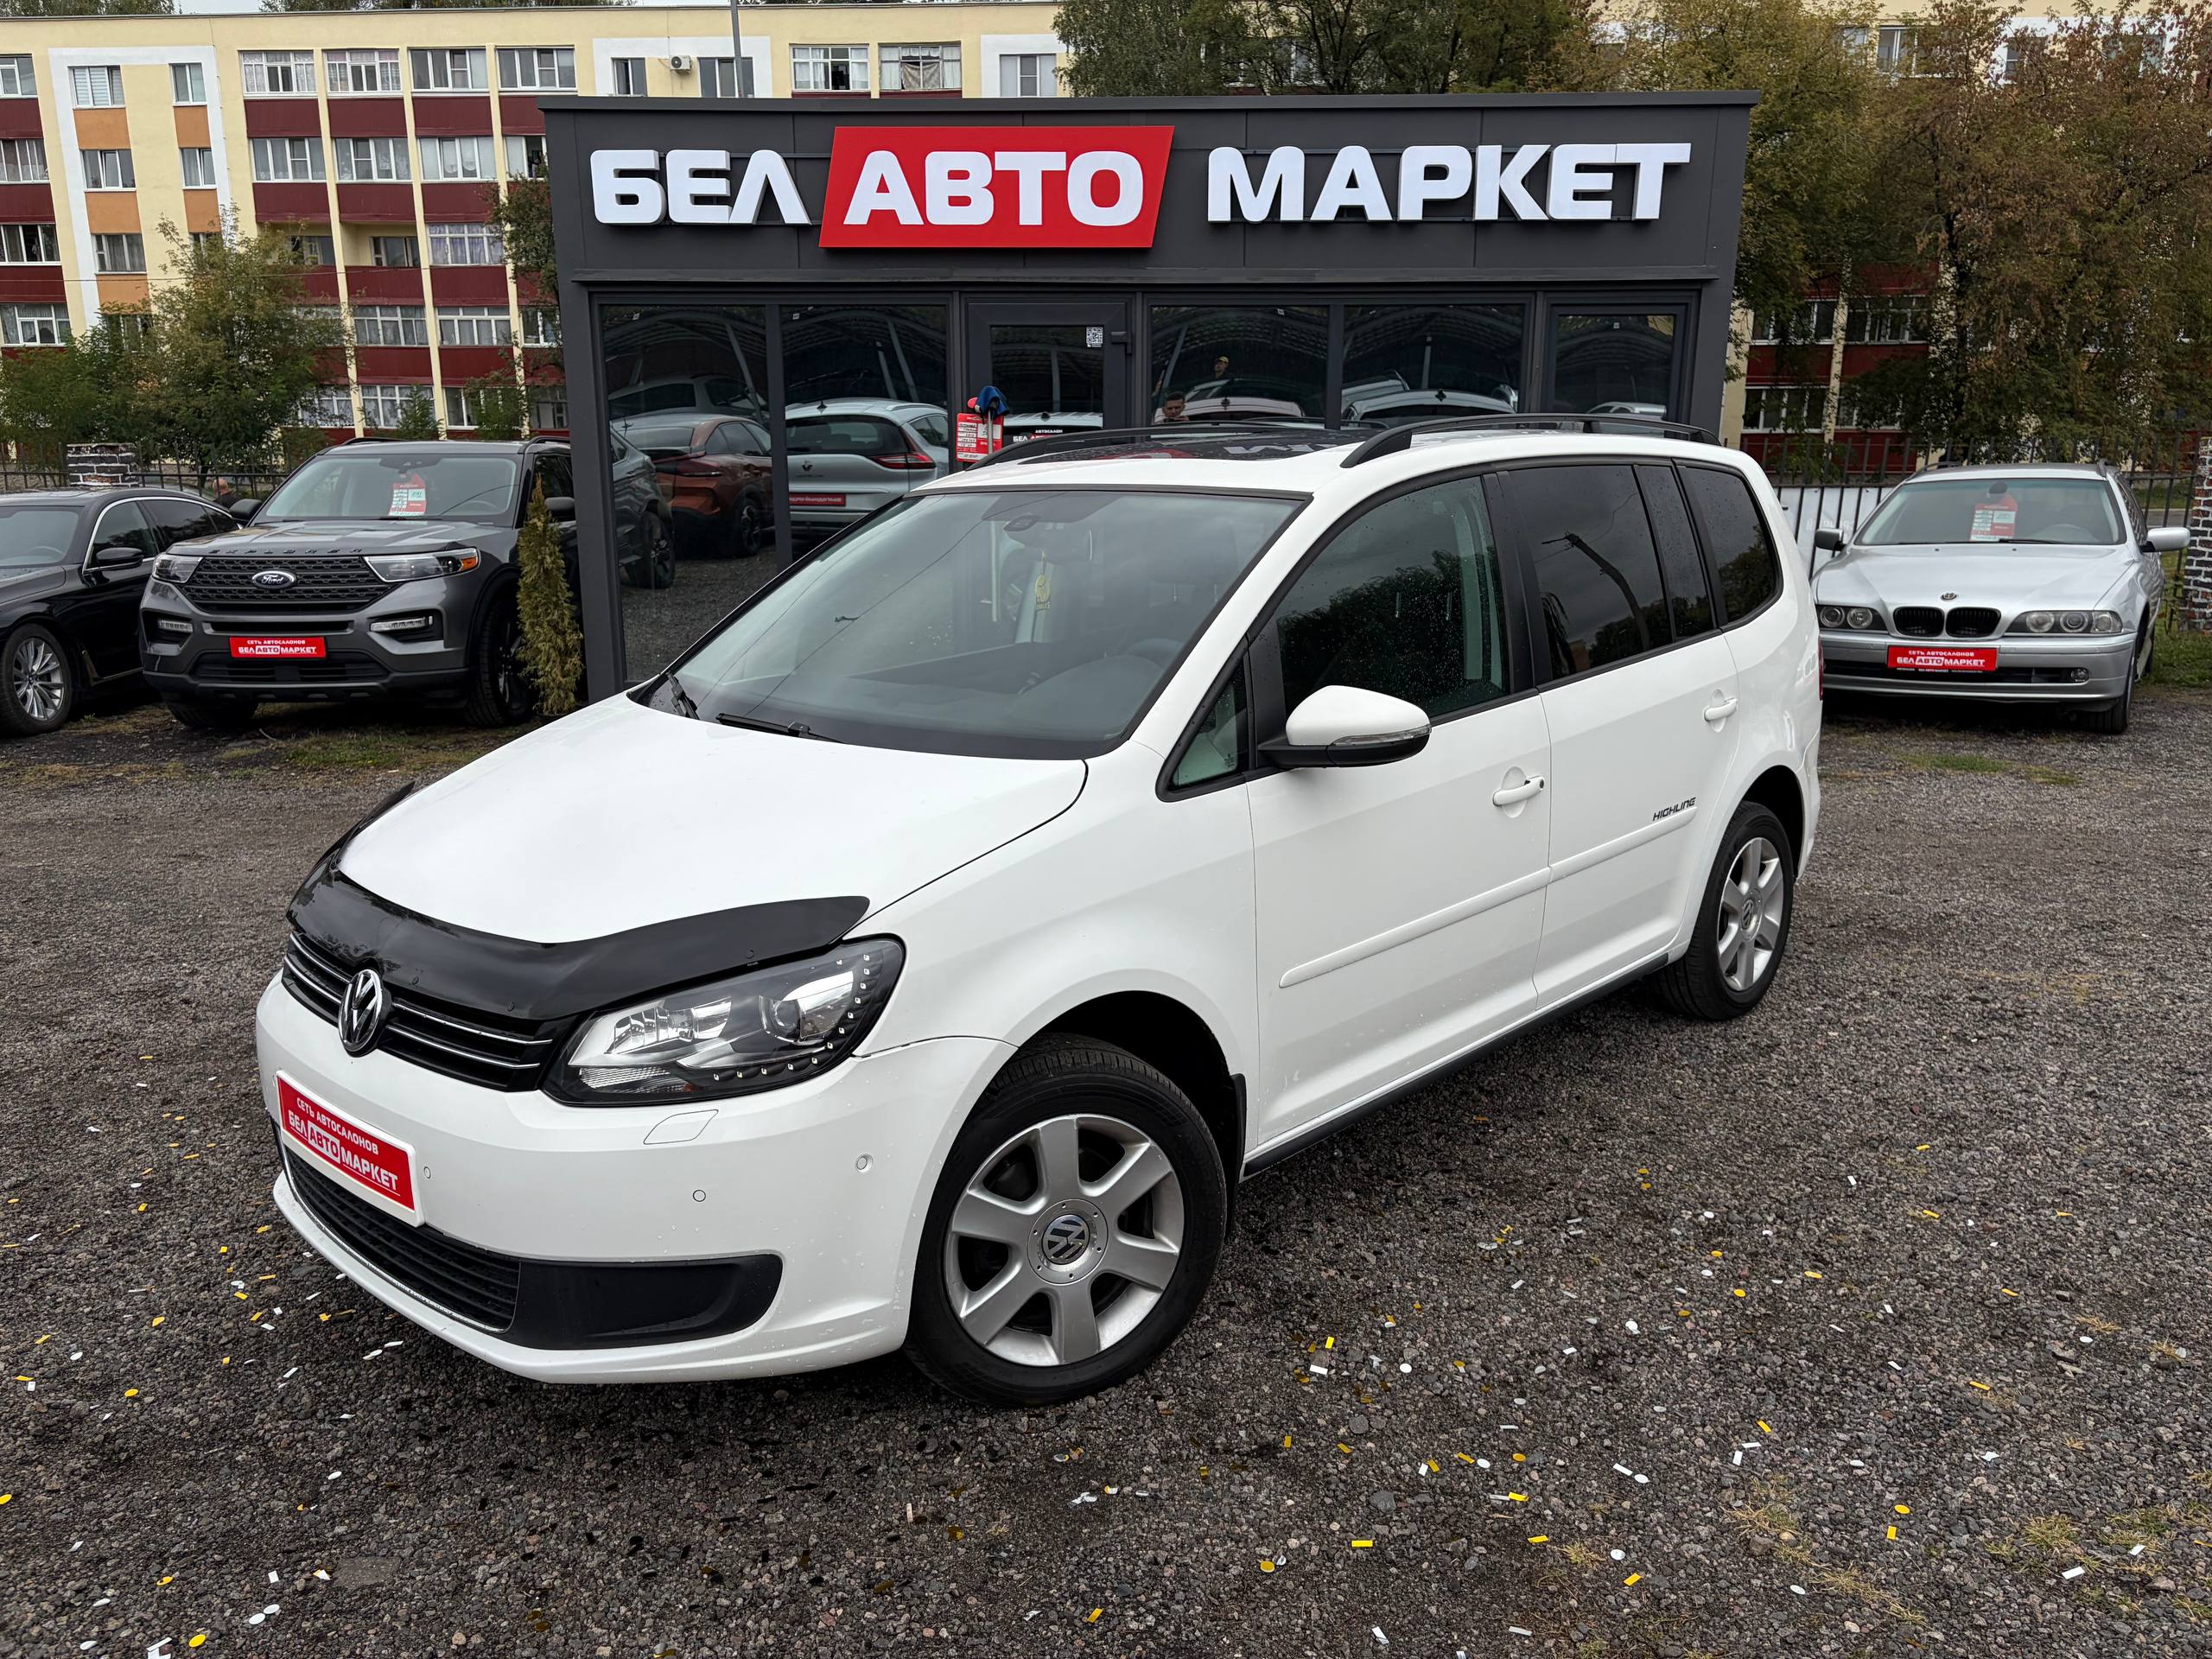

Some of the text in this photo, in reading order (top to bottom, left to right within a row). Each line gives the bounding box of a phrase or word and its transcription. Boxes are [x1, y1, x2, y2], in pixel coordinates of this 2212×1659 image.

[589, 143, 1692, 226] БЕЛ АВТО МАРКЕТ
[261, 574, 284, 583] Ford
[1652, 797, 1696, 821] HIGHLINE
[289, 1109, 398, 1191] БЕЛ АВТО МАРКЕТ
[296, 1097, 379, 1155] СЕТЬ АВТОСАЛОНОВ
